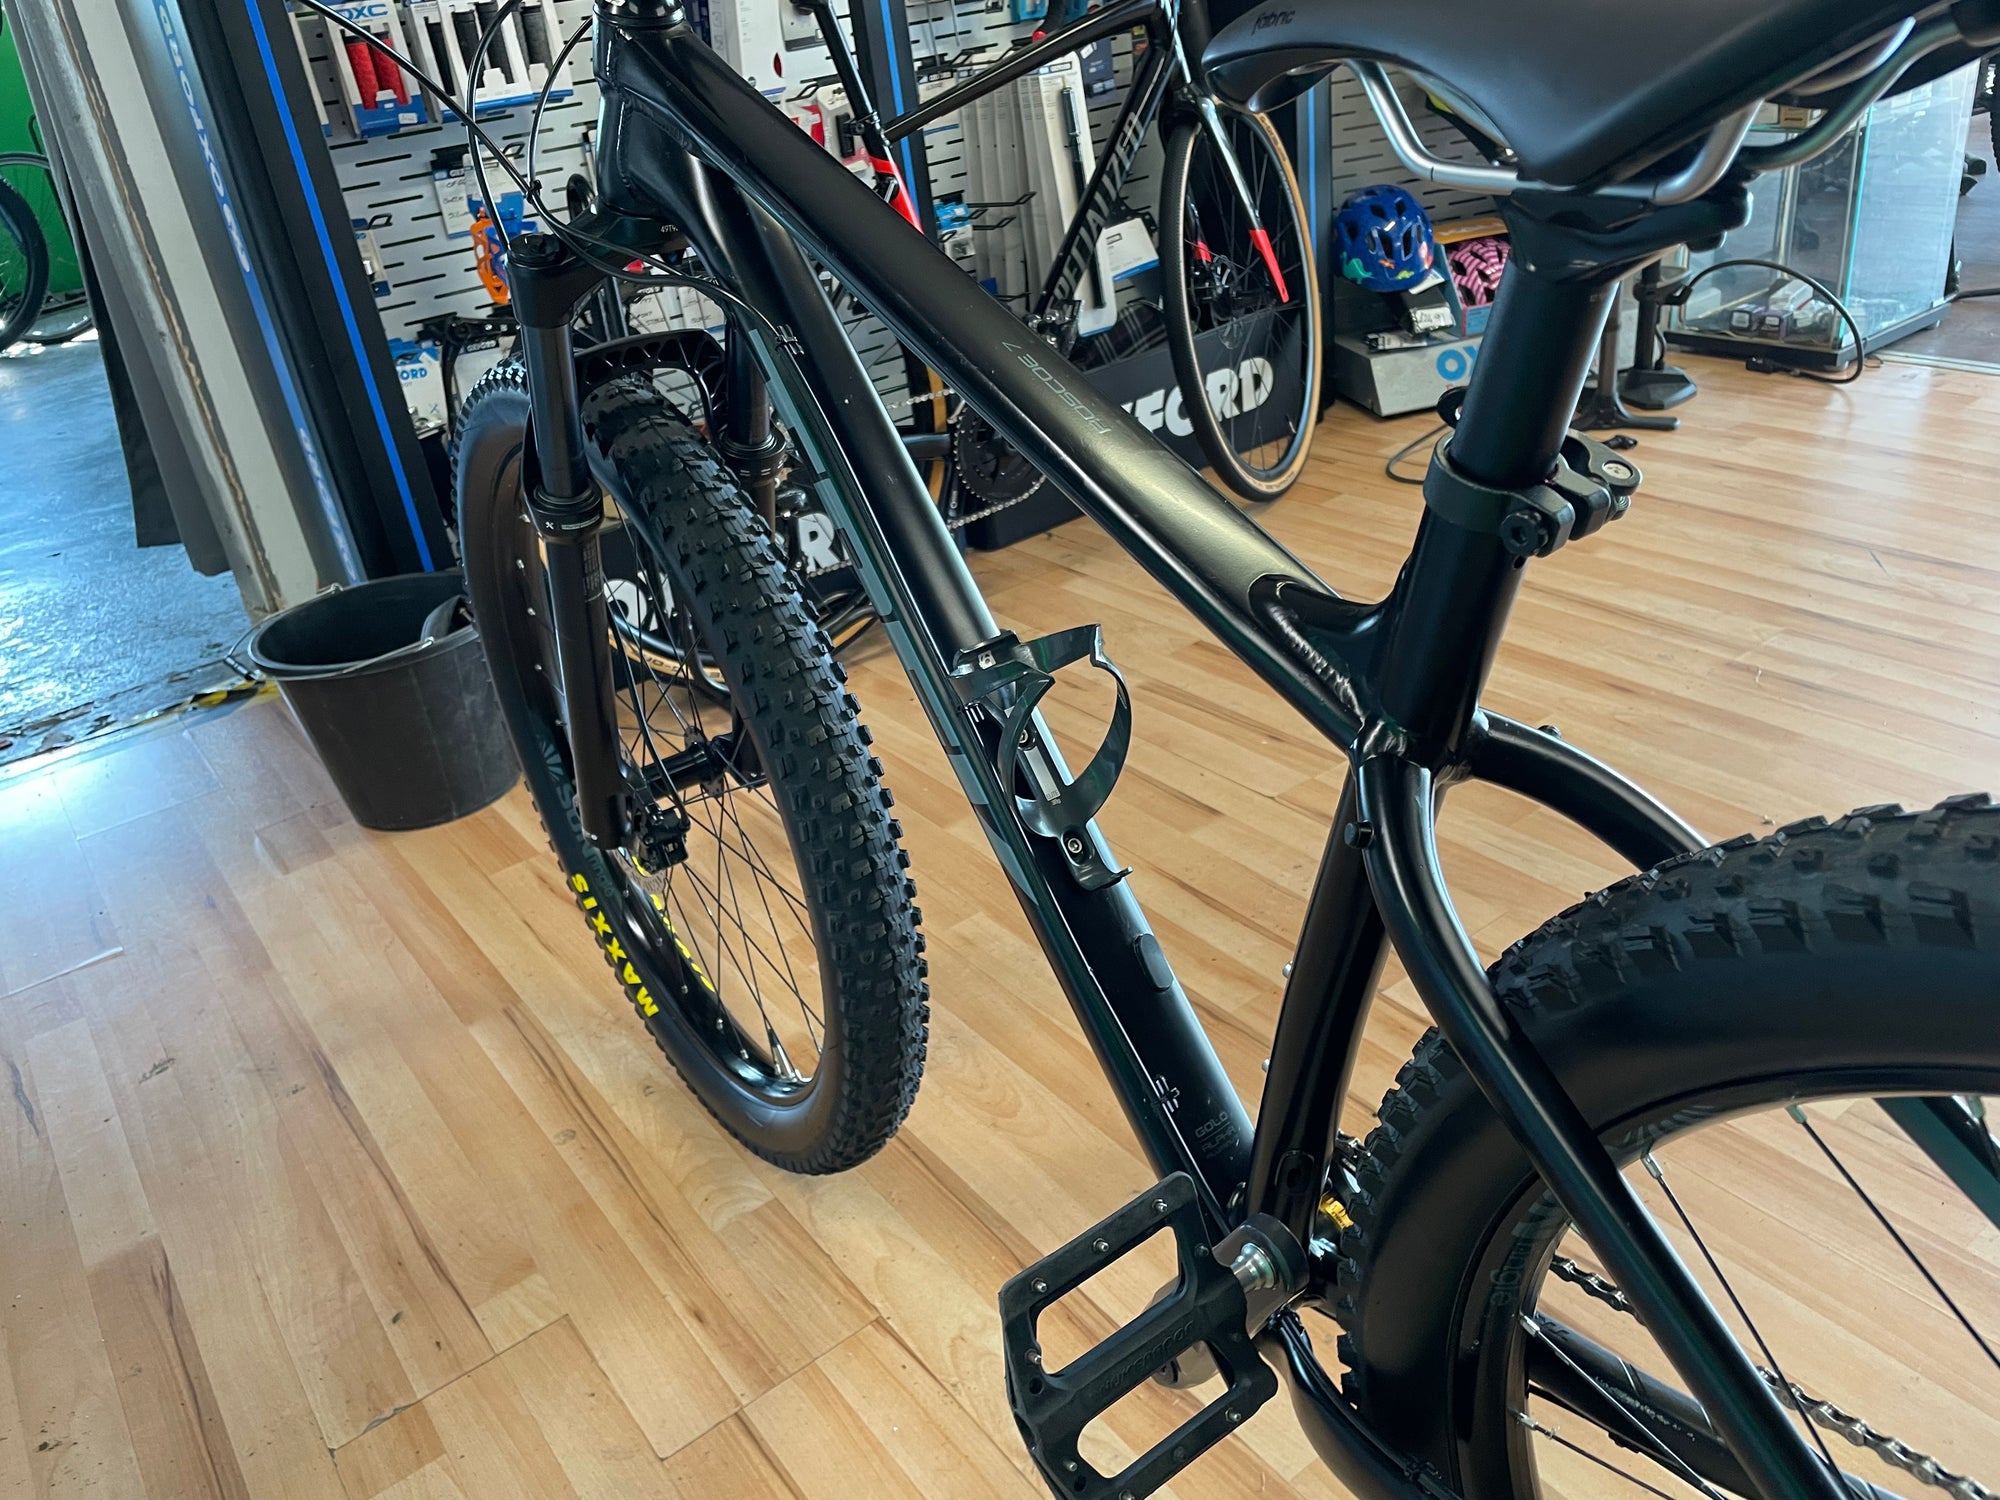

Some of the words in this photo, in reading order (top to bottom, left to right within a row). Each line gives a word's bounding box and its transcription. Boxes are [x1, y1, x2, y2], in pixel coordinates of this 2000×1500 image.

[1251, 10, 1296, 36] fabric
[159, 4, 225, 199] OXFORD
[1017, 353, 1113, 434] ROSCOE
[1120, 356, 1275, 438] FORD
[571, 873, 660, 1018] MAXXIS
[1194, 1111, 1230, 1138] GOLD
